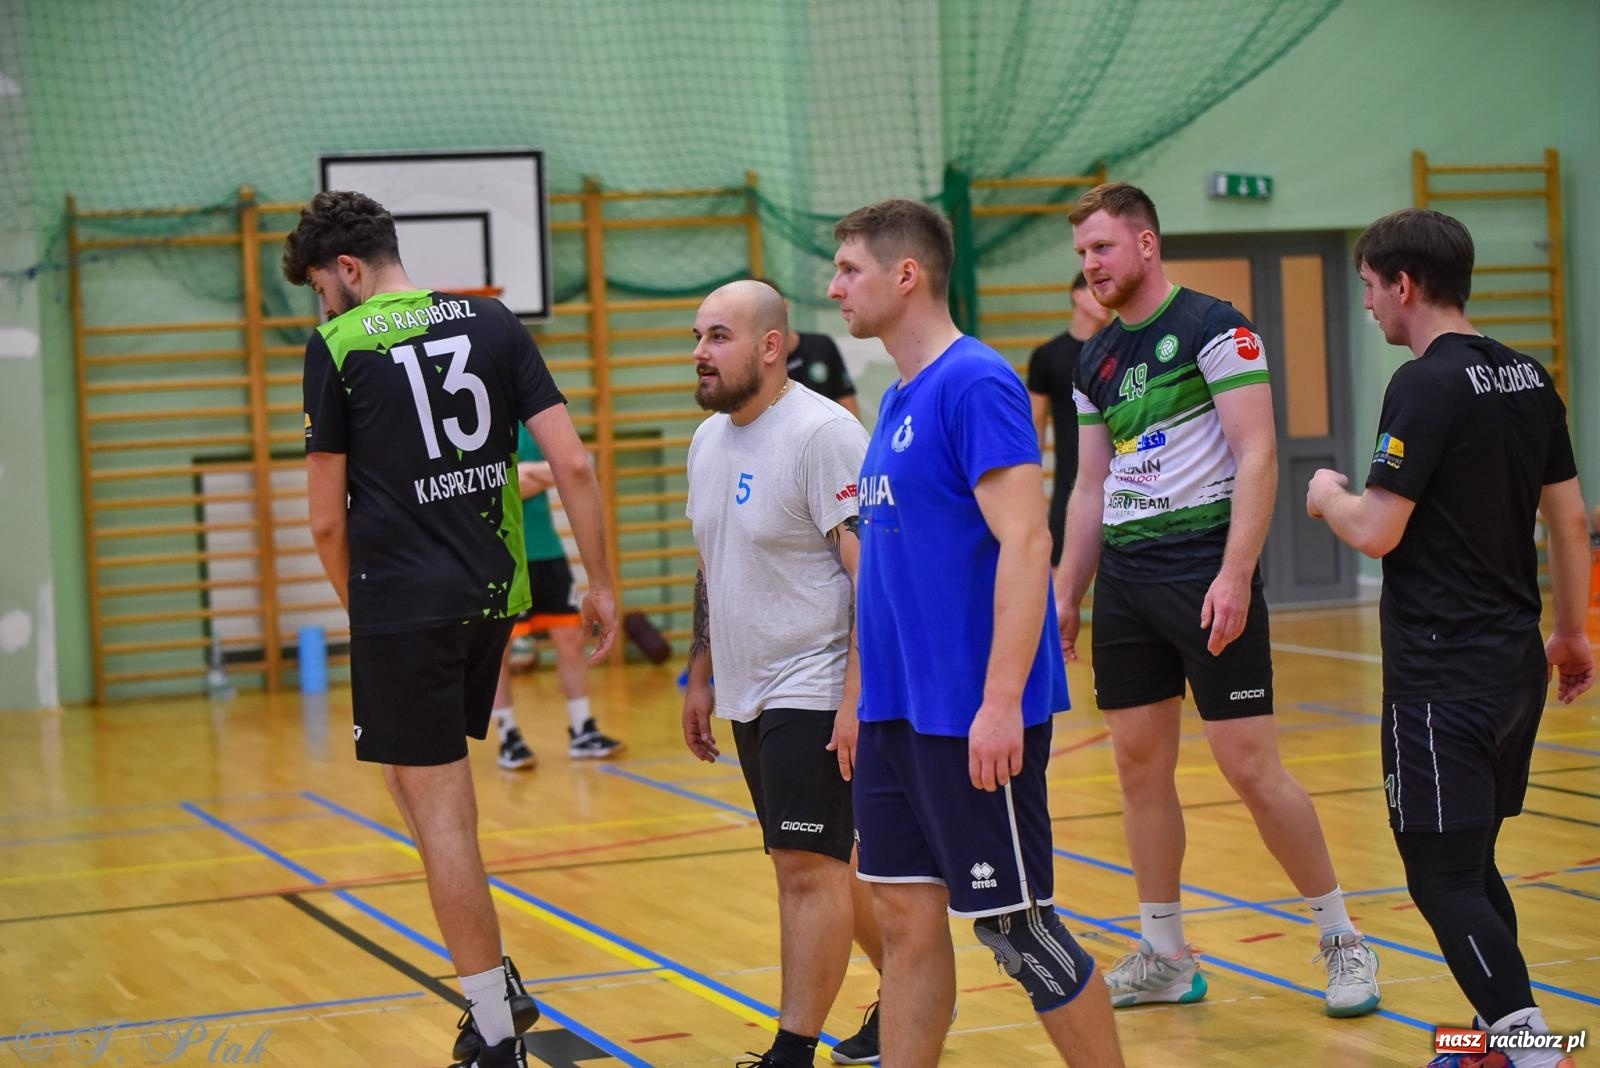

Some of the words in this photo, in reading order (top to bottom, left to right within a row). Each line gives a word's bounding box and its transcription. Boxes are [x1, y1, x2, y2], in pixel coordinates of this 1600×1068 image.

[361, 314, 389, 335] KS
[392, 299, 476, 330] RACIBÓRZ
[1119, 363, 1148, 402] 49
[1465, 364, 1492, 395] KS
[389, 334, 492, 460] 13
[413, 461, 509, 505] KASPRZYCKI
[735, 472, 754, 505] 5
[1230, 688, 1265, 700] GIOCCA
[781, 820, 824, 833] GIOCCA
[971, 878, 998, 889] errea
